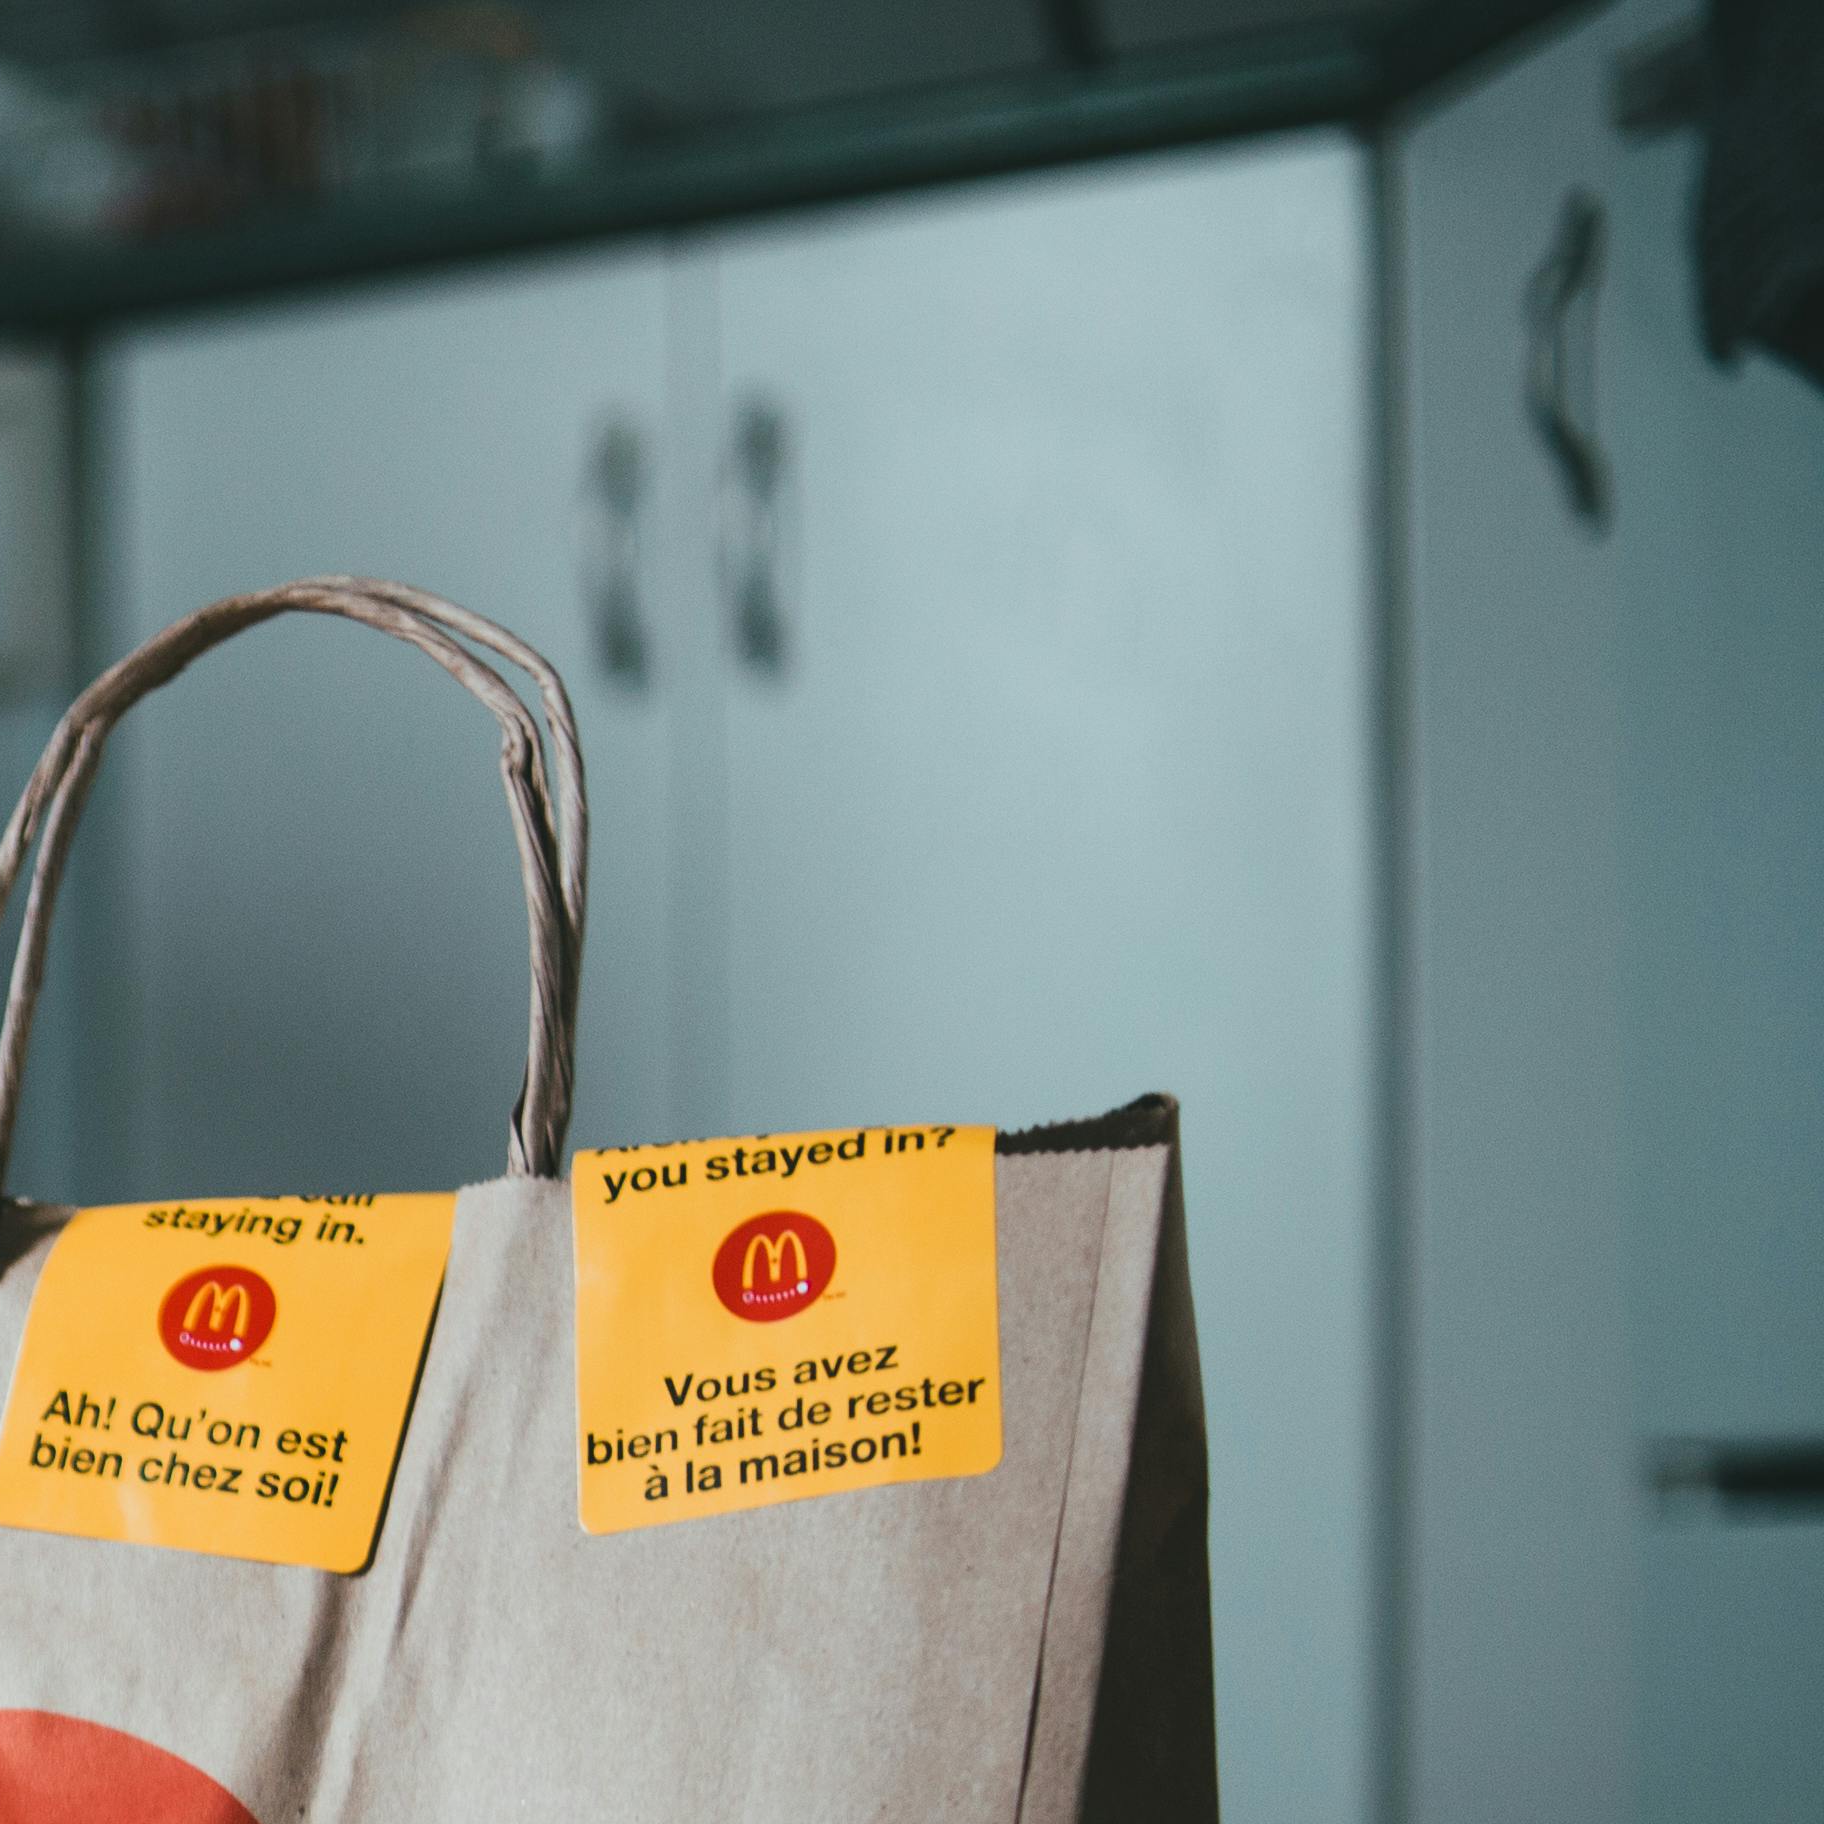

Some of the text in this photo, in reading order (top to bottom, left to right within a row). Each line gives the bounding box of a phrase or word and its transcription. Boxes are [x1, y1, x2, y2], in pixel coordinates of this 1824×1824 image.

[602, 1161, 688, 1204] you
[705, 1131, 866, 1181] stayed
[884, 1126, 956, 1154] in?
[143, 1206, 366, 1245] staying in.
[664, 1345, 898, 1408] Vous avez
[40, 1389, 349, 1463] Ah! Qu'on est
[587, 1376, 986, 1465] bien fait de rester
[29, 1432, 340, 1508] bien chez soi!
[644, 1421, 922, 1501] à la maison!
